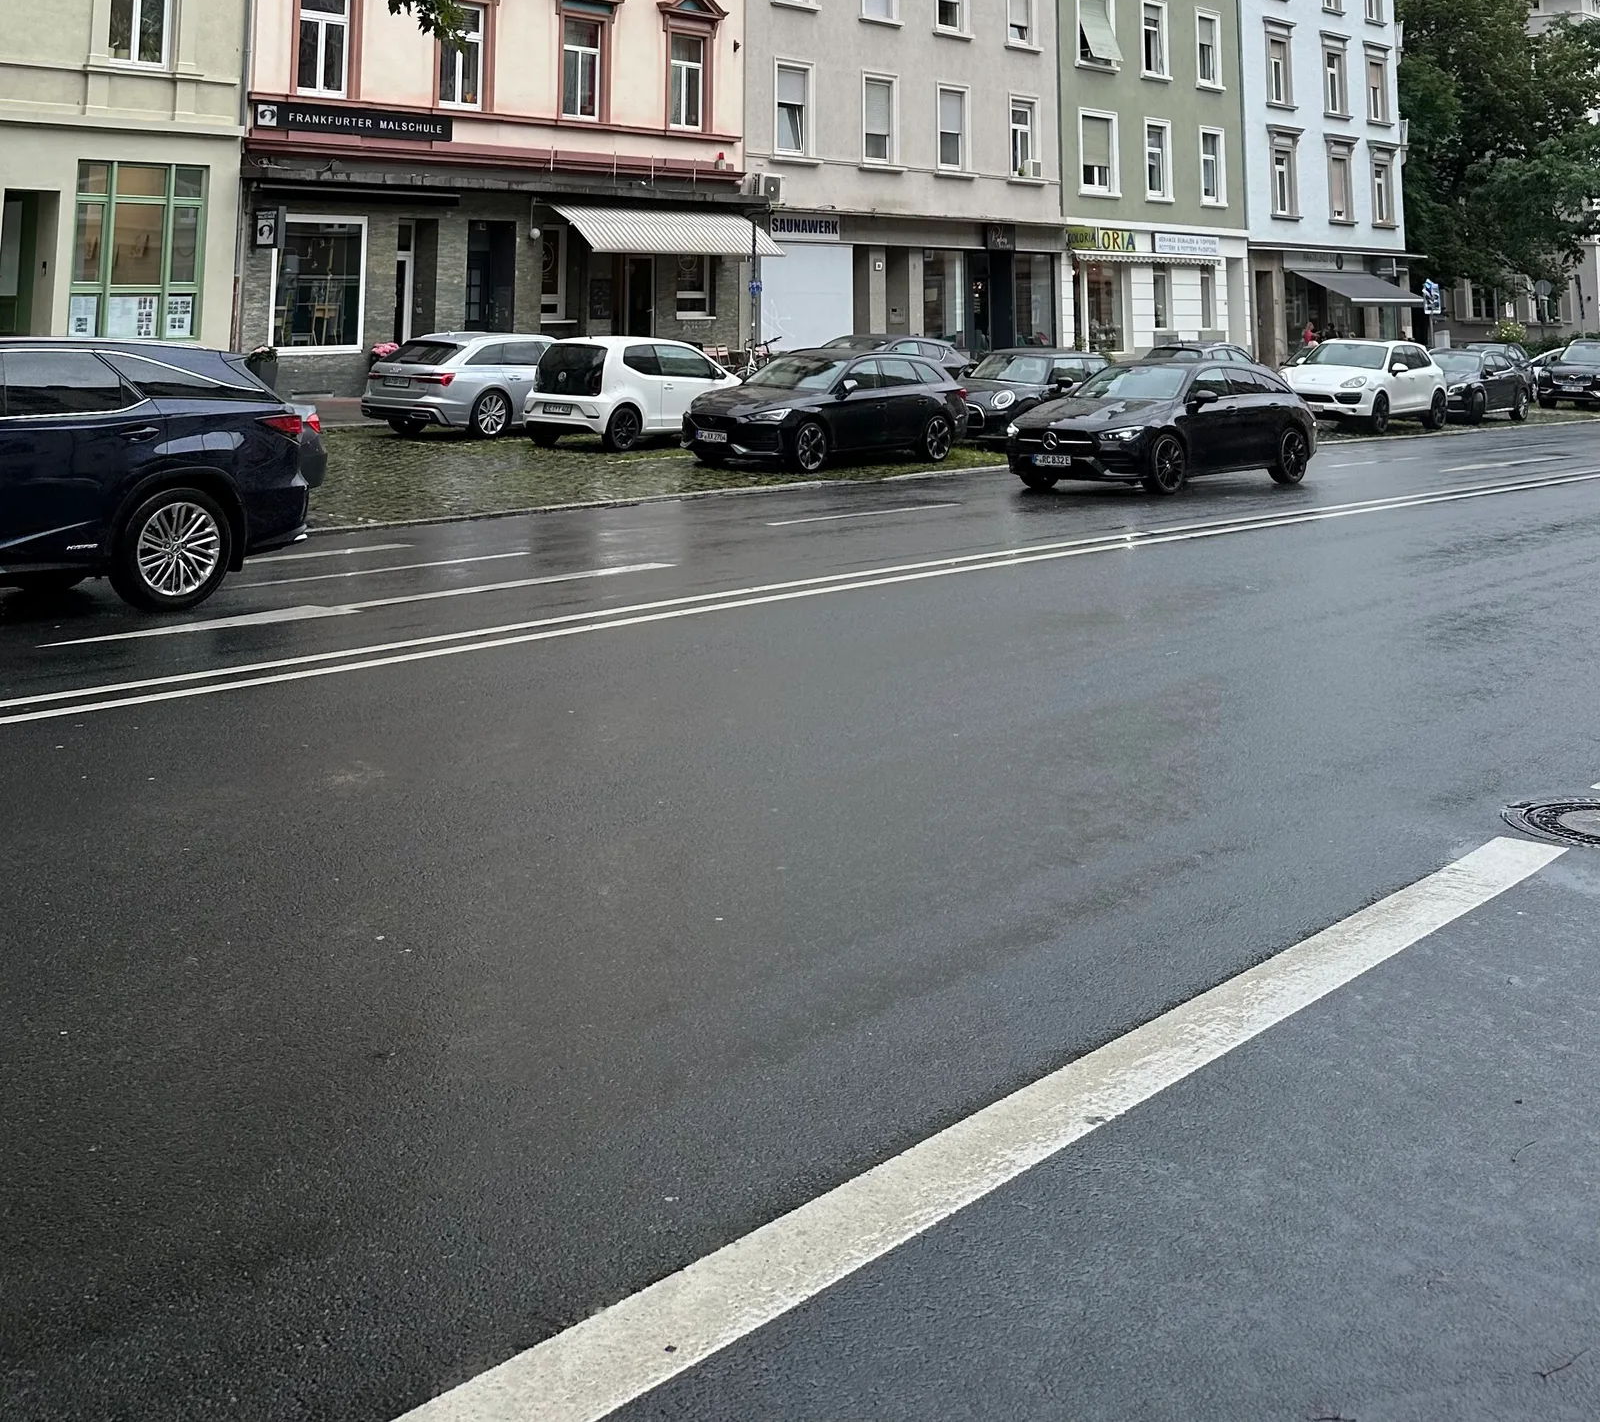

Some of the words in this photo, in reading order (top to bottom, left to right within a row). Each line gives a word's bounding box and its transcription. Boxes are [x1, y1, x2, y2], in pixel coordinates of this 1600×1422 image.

[288, 112, 372, 128] FRANKFURTER
[379, 120, 443, 134] MALSCHULE
[771, 218, 838, 234] SAUNAWERK
[1067, 232, 1096, 243] COLORIA
